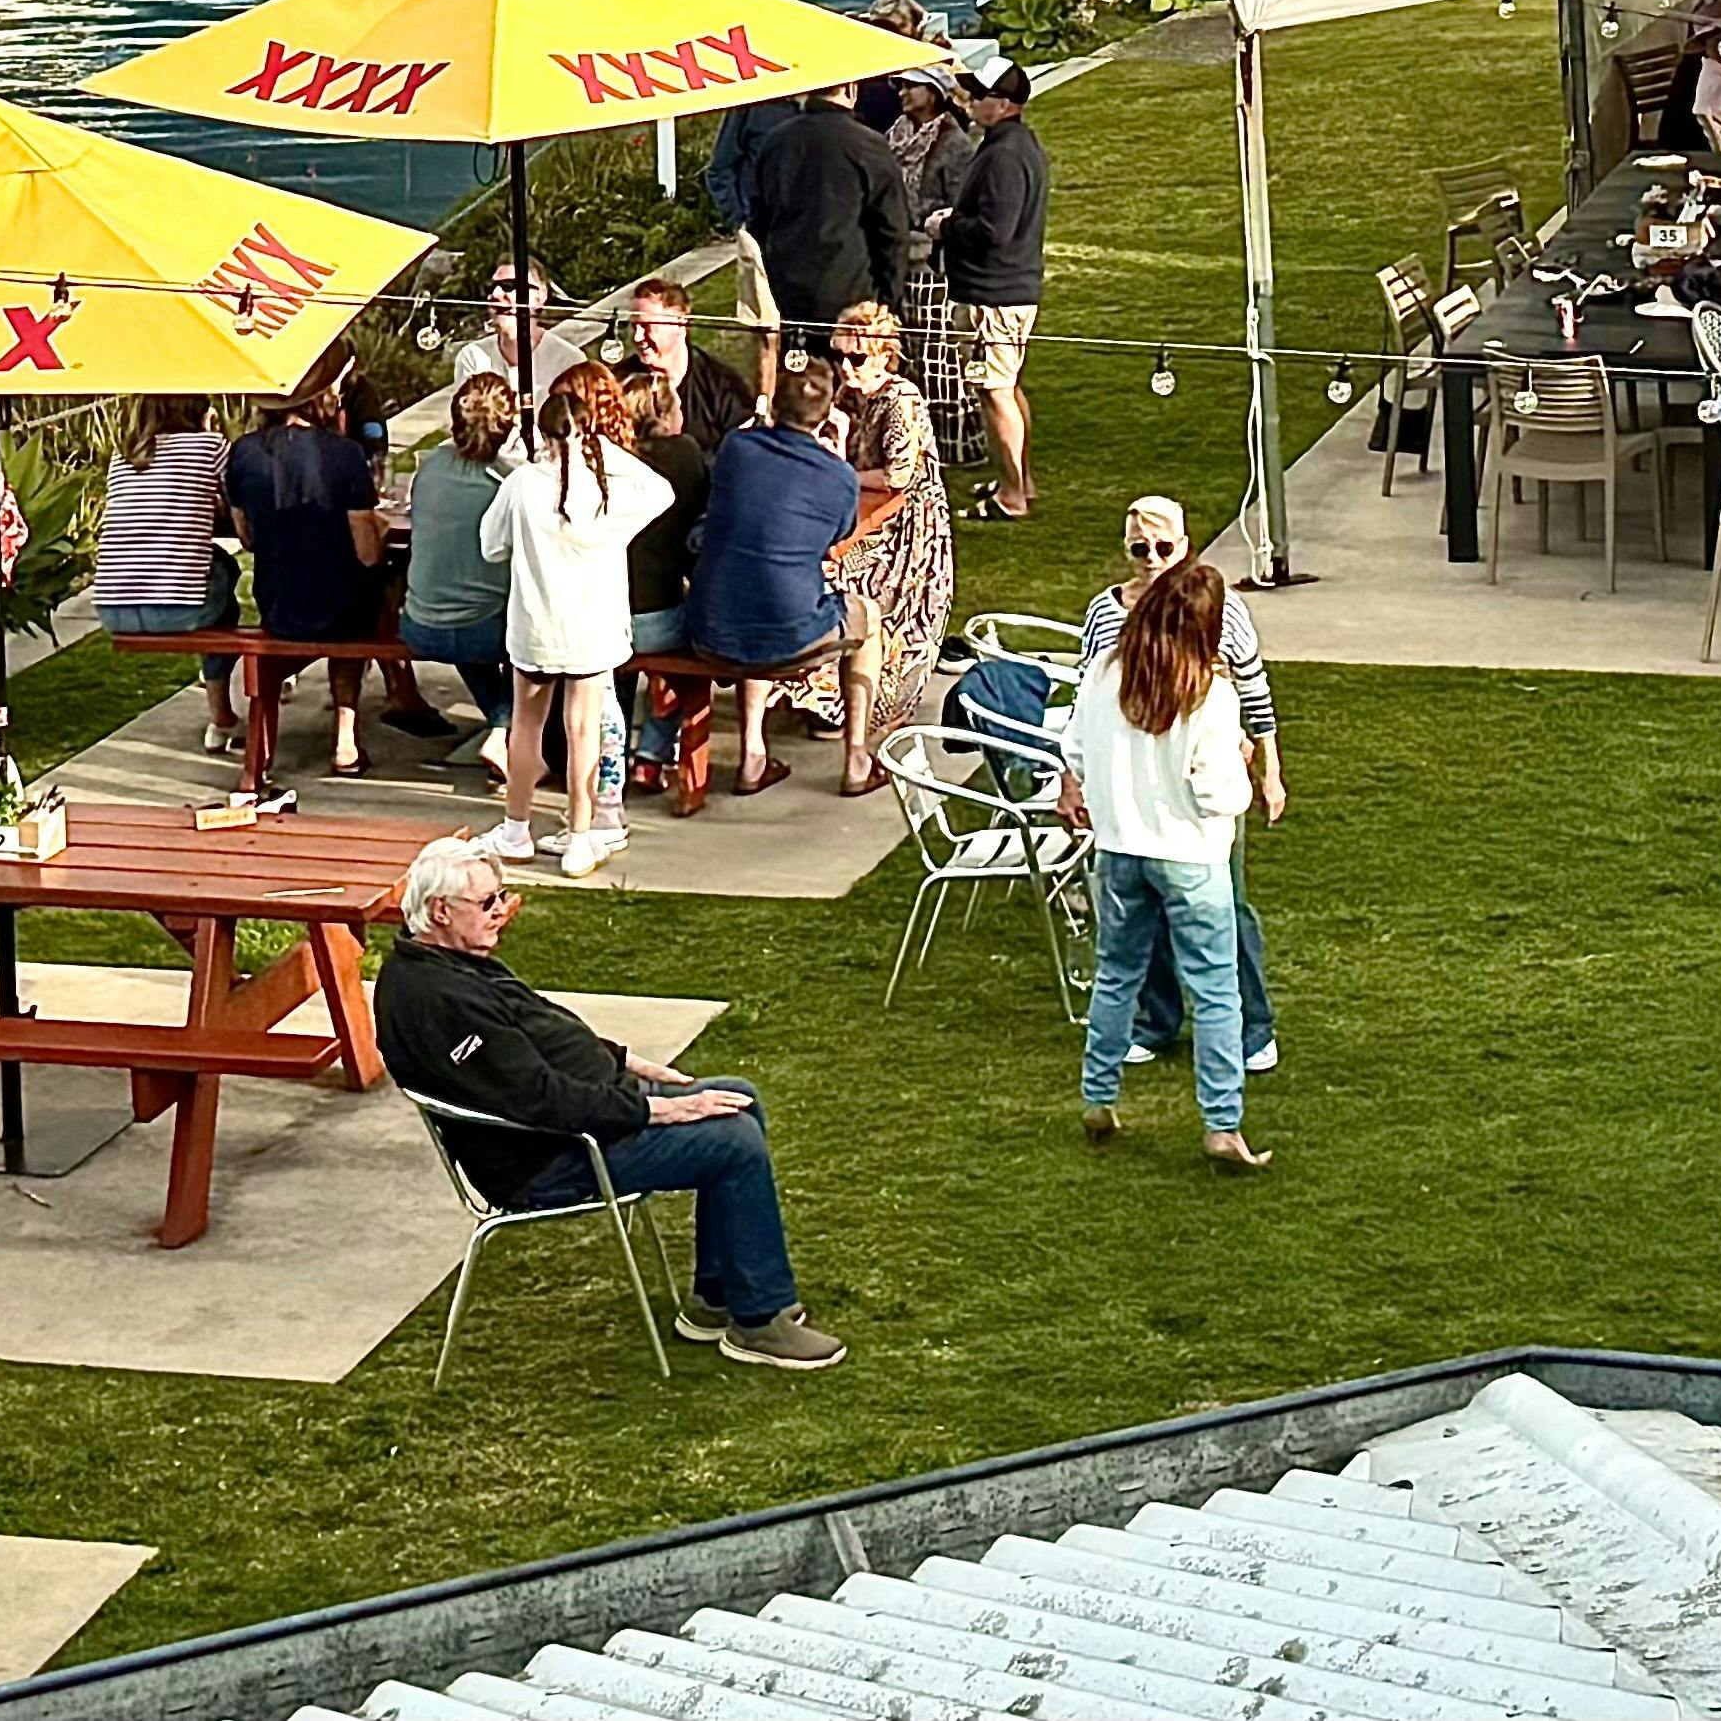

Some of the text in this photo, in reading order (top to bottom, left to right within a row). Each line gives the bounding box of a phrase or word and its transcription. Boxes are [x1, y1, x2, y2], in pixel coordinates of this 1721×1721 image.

[224, 40, 451, 115] XXXX
[548, 24, 791, 104] XXXX
[1659, 229, 1678, 243] 35
